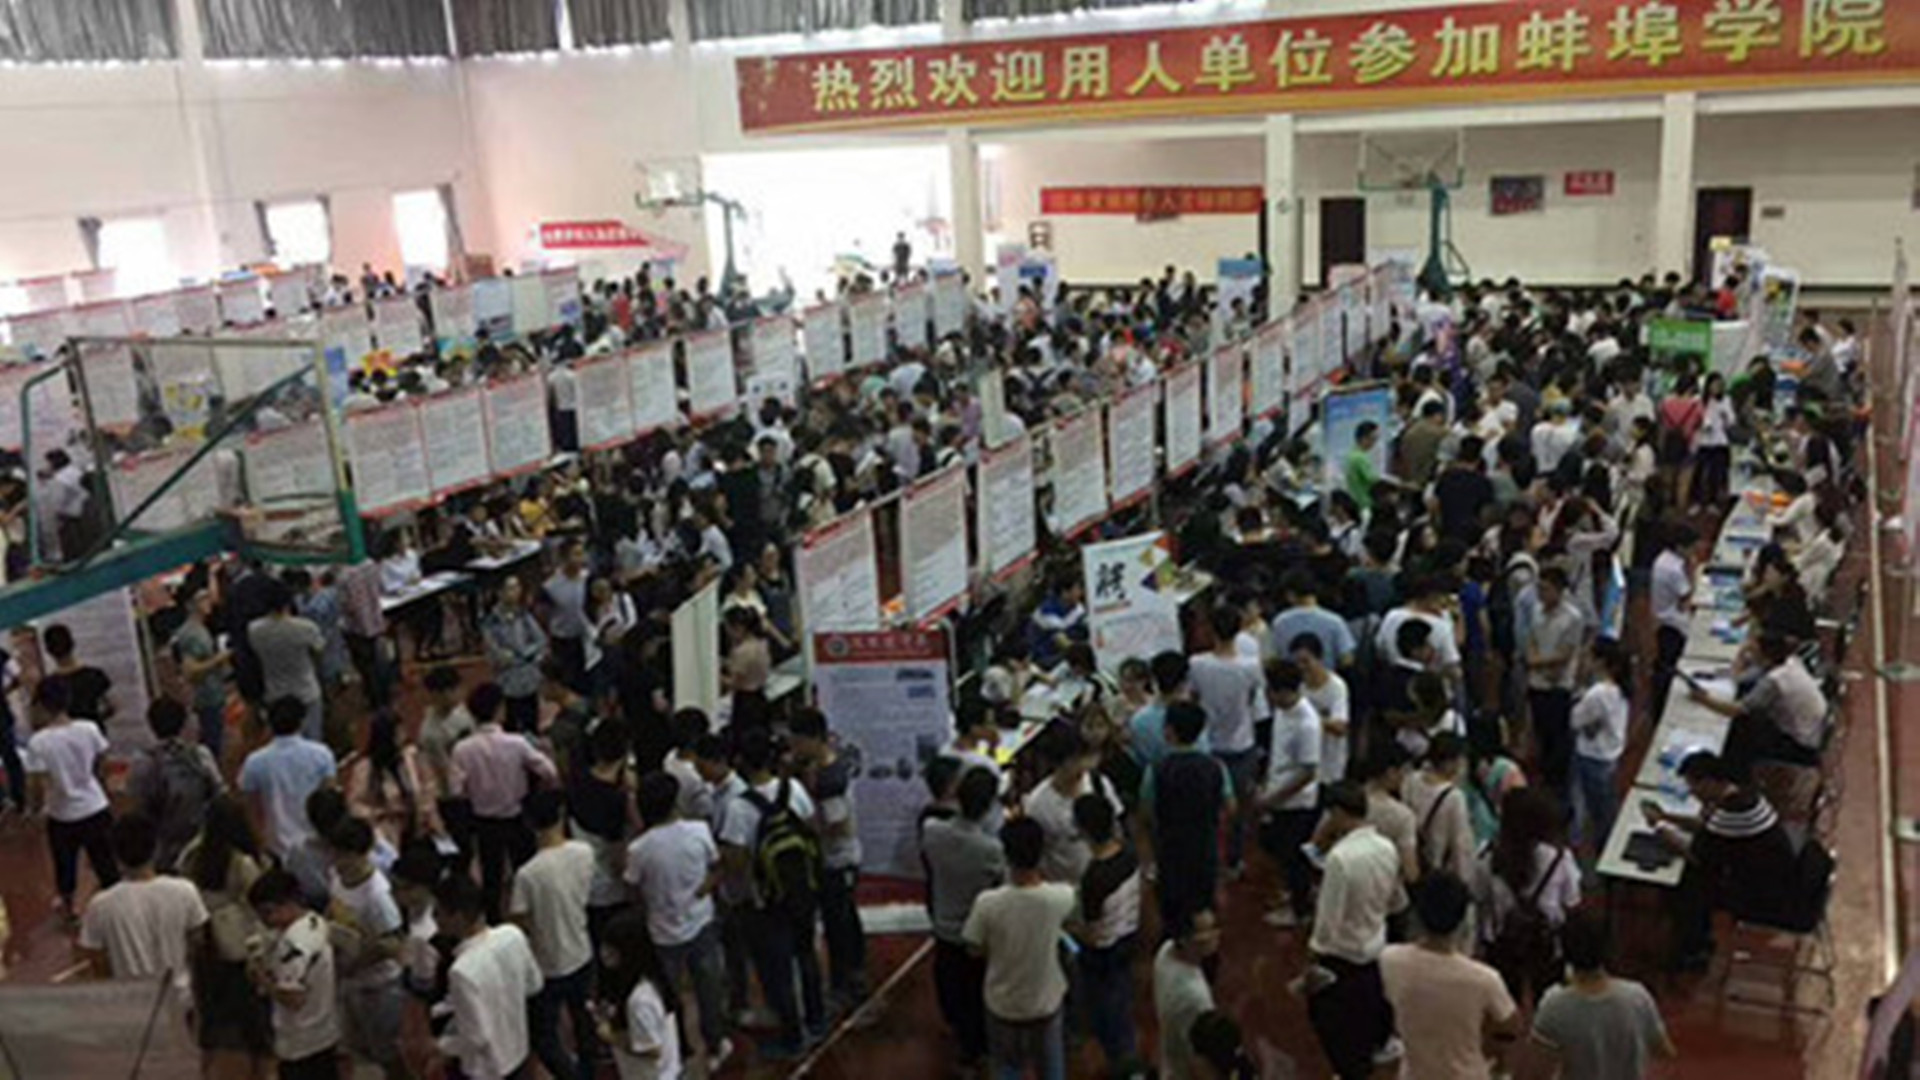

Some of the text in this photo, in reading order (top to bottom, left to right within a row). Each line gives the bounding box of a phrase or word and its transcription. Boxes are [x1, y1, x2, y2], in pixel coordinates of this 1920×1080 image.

[812, 0, 1885, 112] 热烈欢迎用人单位参加蚌埠学院
